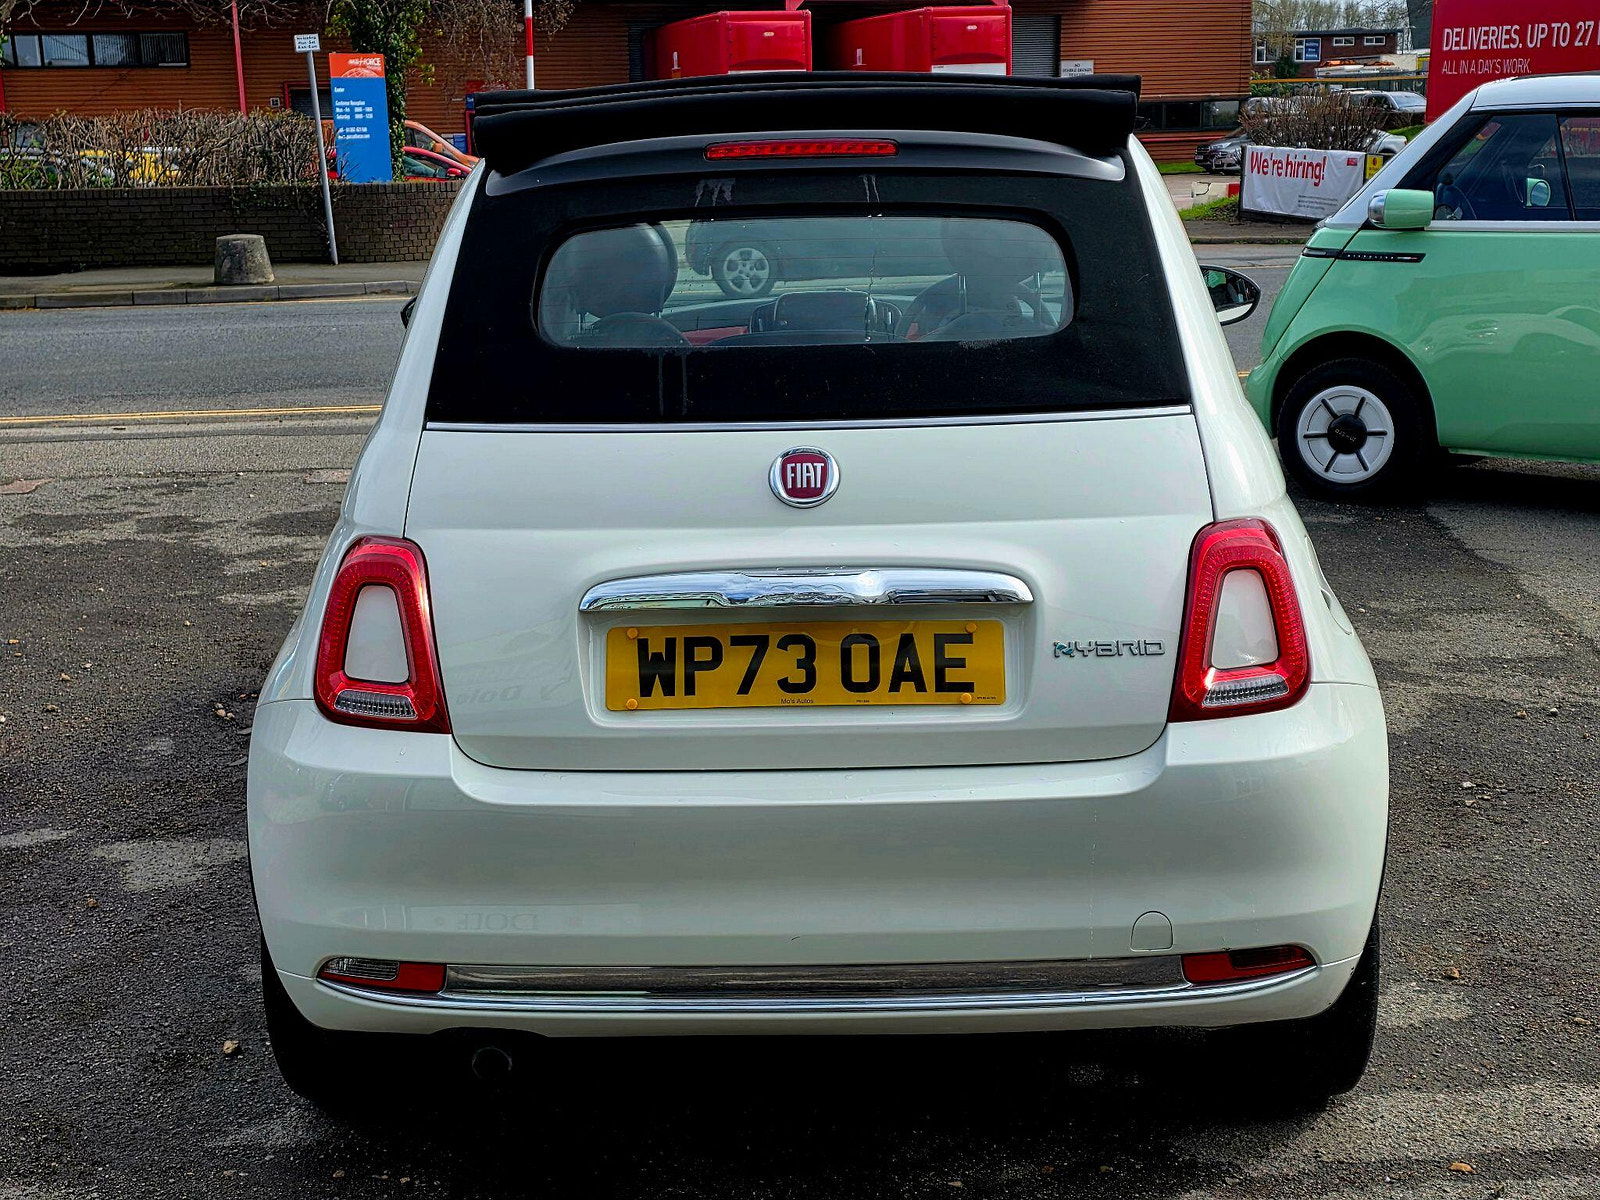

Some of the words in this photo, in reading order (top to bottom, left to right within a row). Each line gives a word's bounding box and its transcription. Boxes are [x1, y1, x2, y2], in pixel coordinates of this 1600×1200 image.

[1443, 25, 1523, 51] DELIVERIES.
[1527, 23, 1548, 49] UP
[1551, 22, 1570, 48] TO
[1574, 21, 1595, 47] 27
[1441, 60, 1458, 75] ALL
[1459, 60, 1469, 74] IN
[1470, 60, 1476, 74] A
[1478, 59, 1501, 74] DAY'S
[1503, 58, 1532, 74] WORK.
[1250, 151, 1284, 178] We're
[1285, 153, 1327, 188] hiring!
[786, 462, 825, 489] FIAT
[636, 633, 818, 698] WP73
[840, 632, 975, 695] OAE
